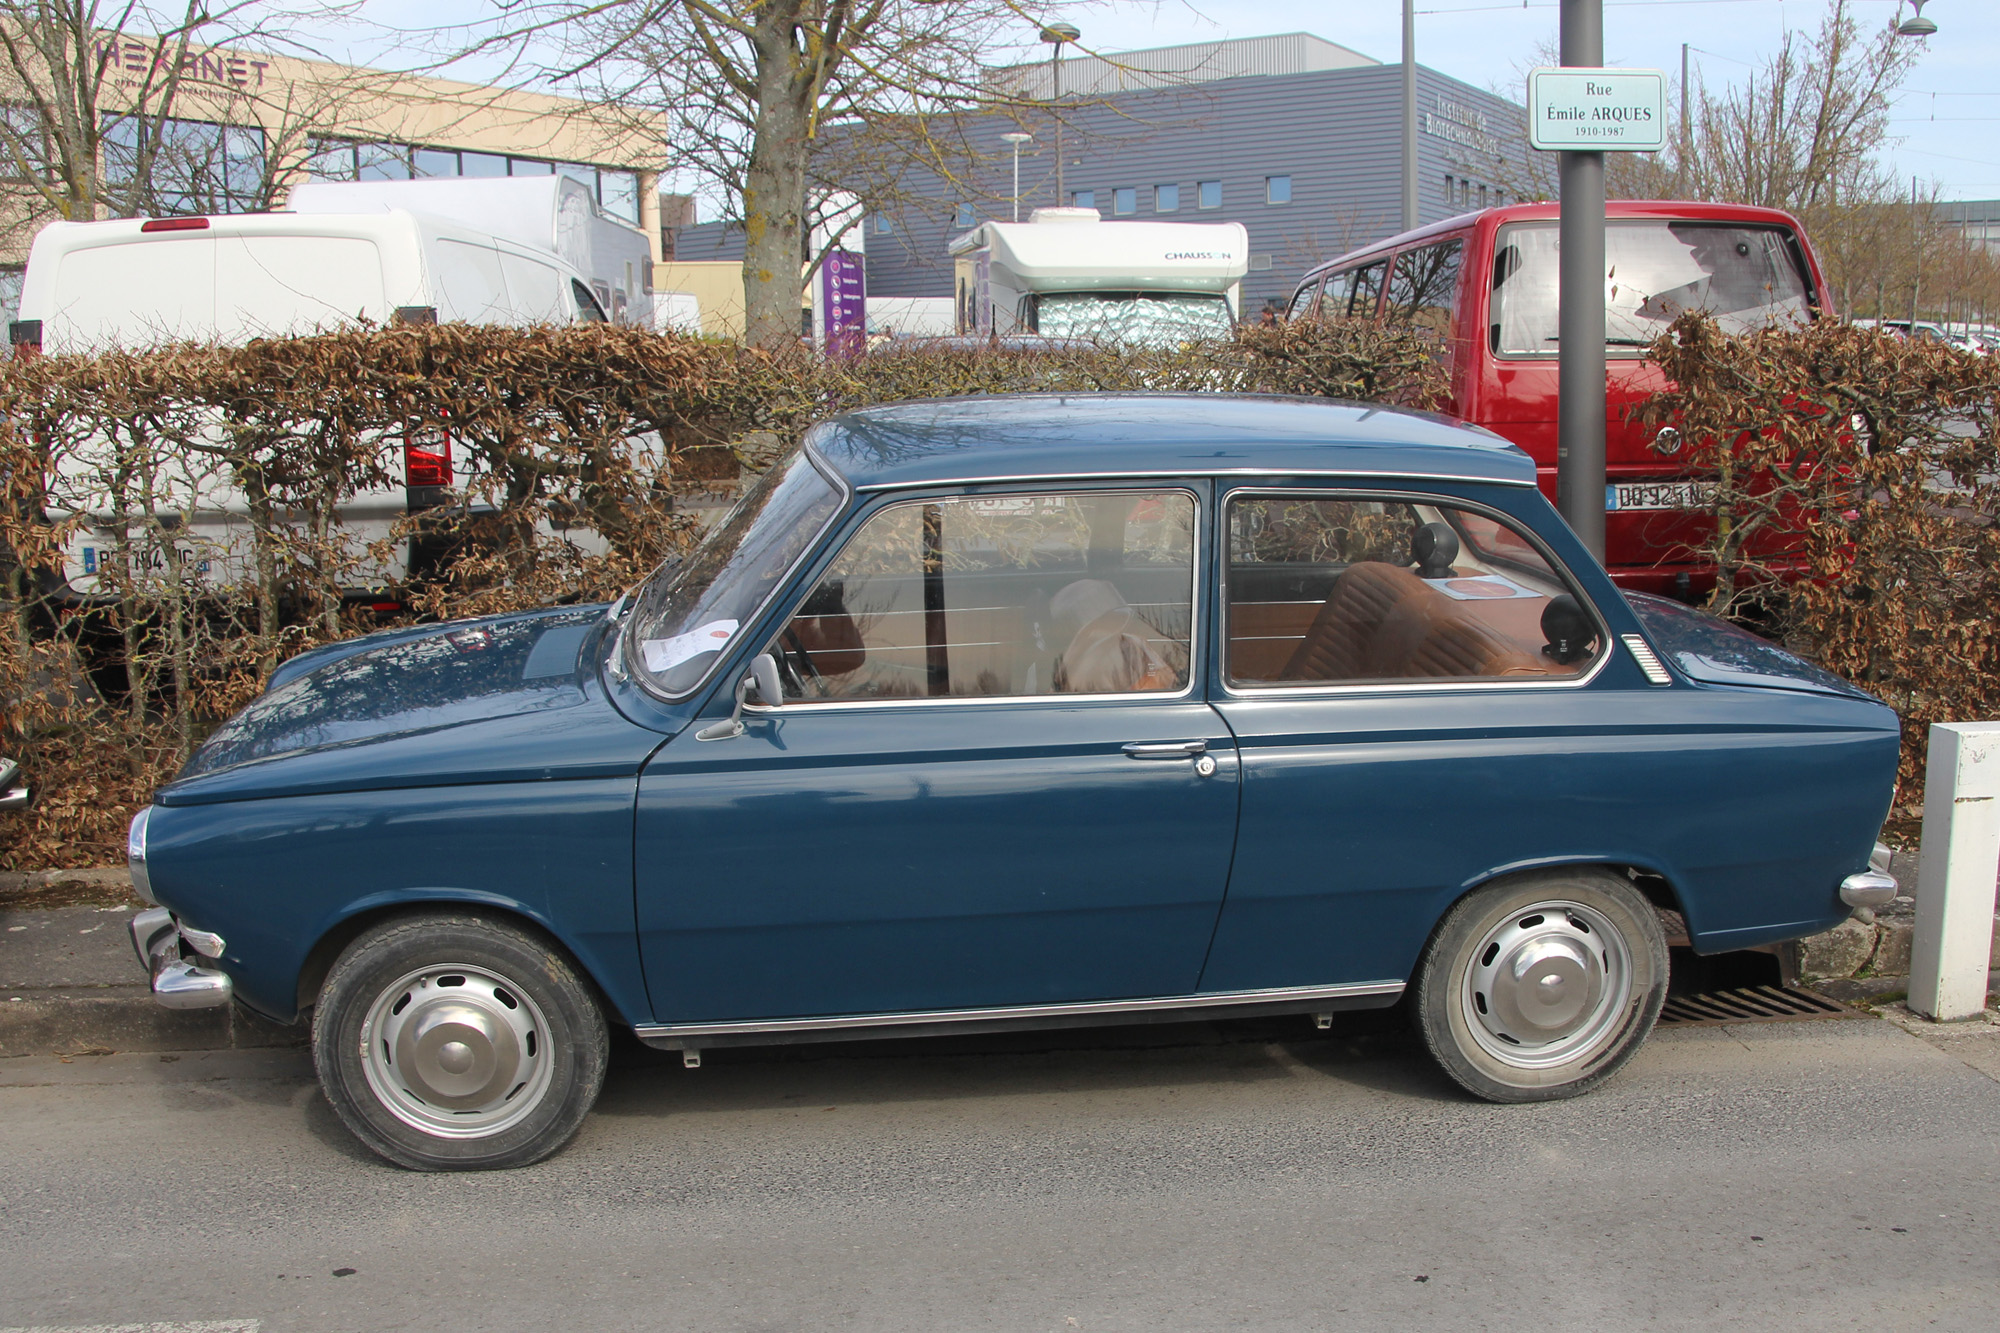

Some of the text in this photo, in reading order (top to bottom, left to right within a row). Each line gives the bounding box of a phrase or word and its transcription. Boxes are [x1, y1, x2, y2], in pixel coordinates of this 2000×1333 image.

[1586, 82, 1612, 96] Rue
[1547, 102, 1652, 122] Émile ARQUES
[1476, 110, 1487, 133] de
[1575, 126, 1625, 136] 1910-1987
[1164, 252, 1232, 260] CHAUSSON
